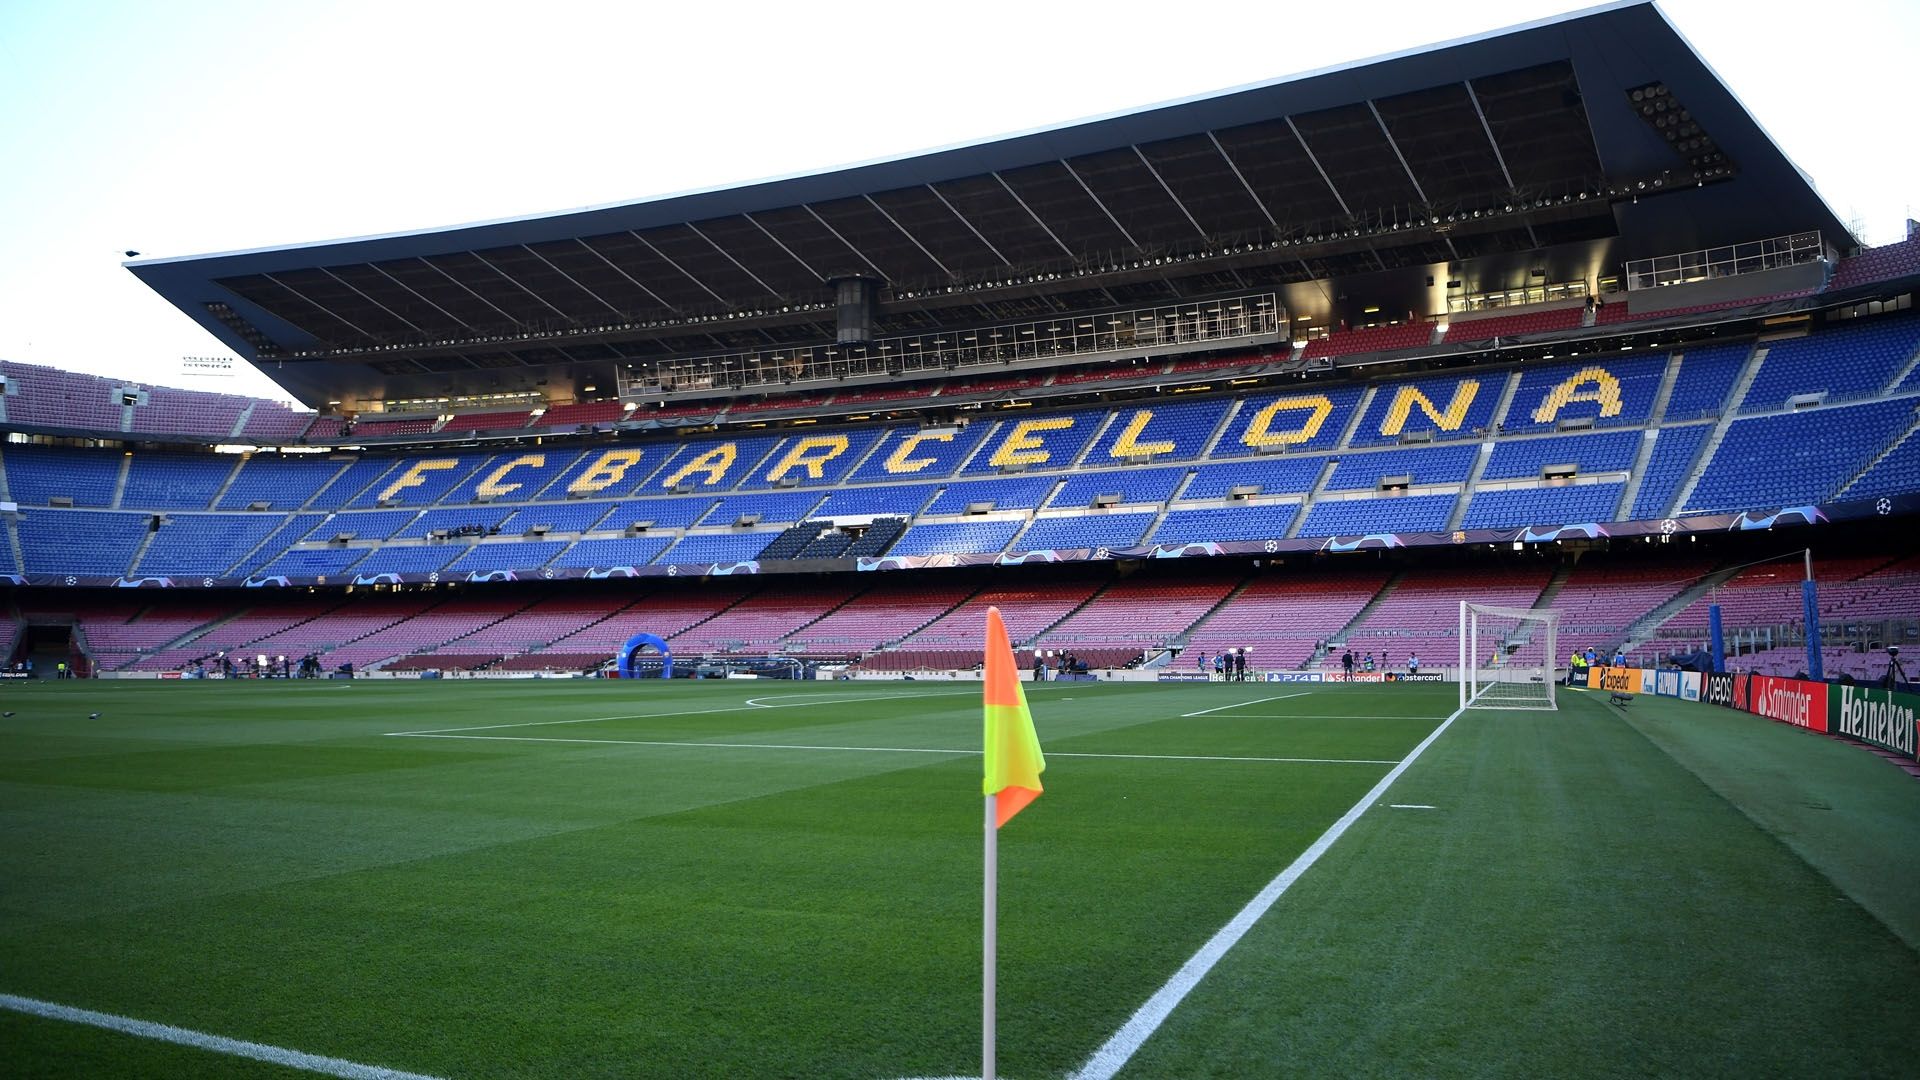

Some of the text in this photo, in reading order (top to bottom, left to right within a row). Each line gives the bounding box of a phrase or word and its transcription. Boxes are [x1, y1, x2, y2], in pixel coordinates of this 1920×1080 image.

[378, 366, 1623, 500] FC BARCELONA
[1212, 674, 1257, 682] Heieen
[1283, 674, 1309, 682] PS4
[1606, 668, 1630, 690] Expedia
[1709, 673, 1733, 705] pepsi
[1767, 678, 1812, 728] Santander
[1839, 685, 1914, 755] Heineken
